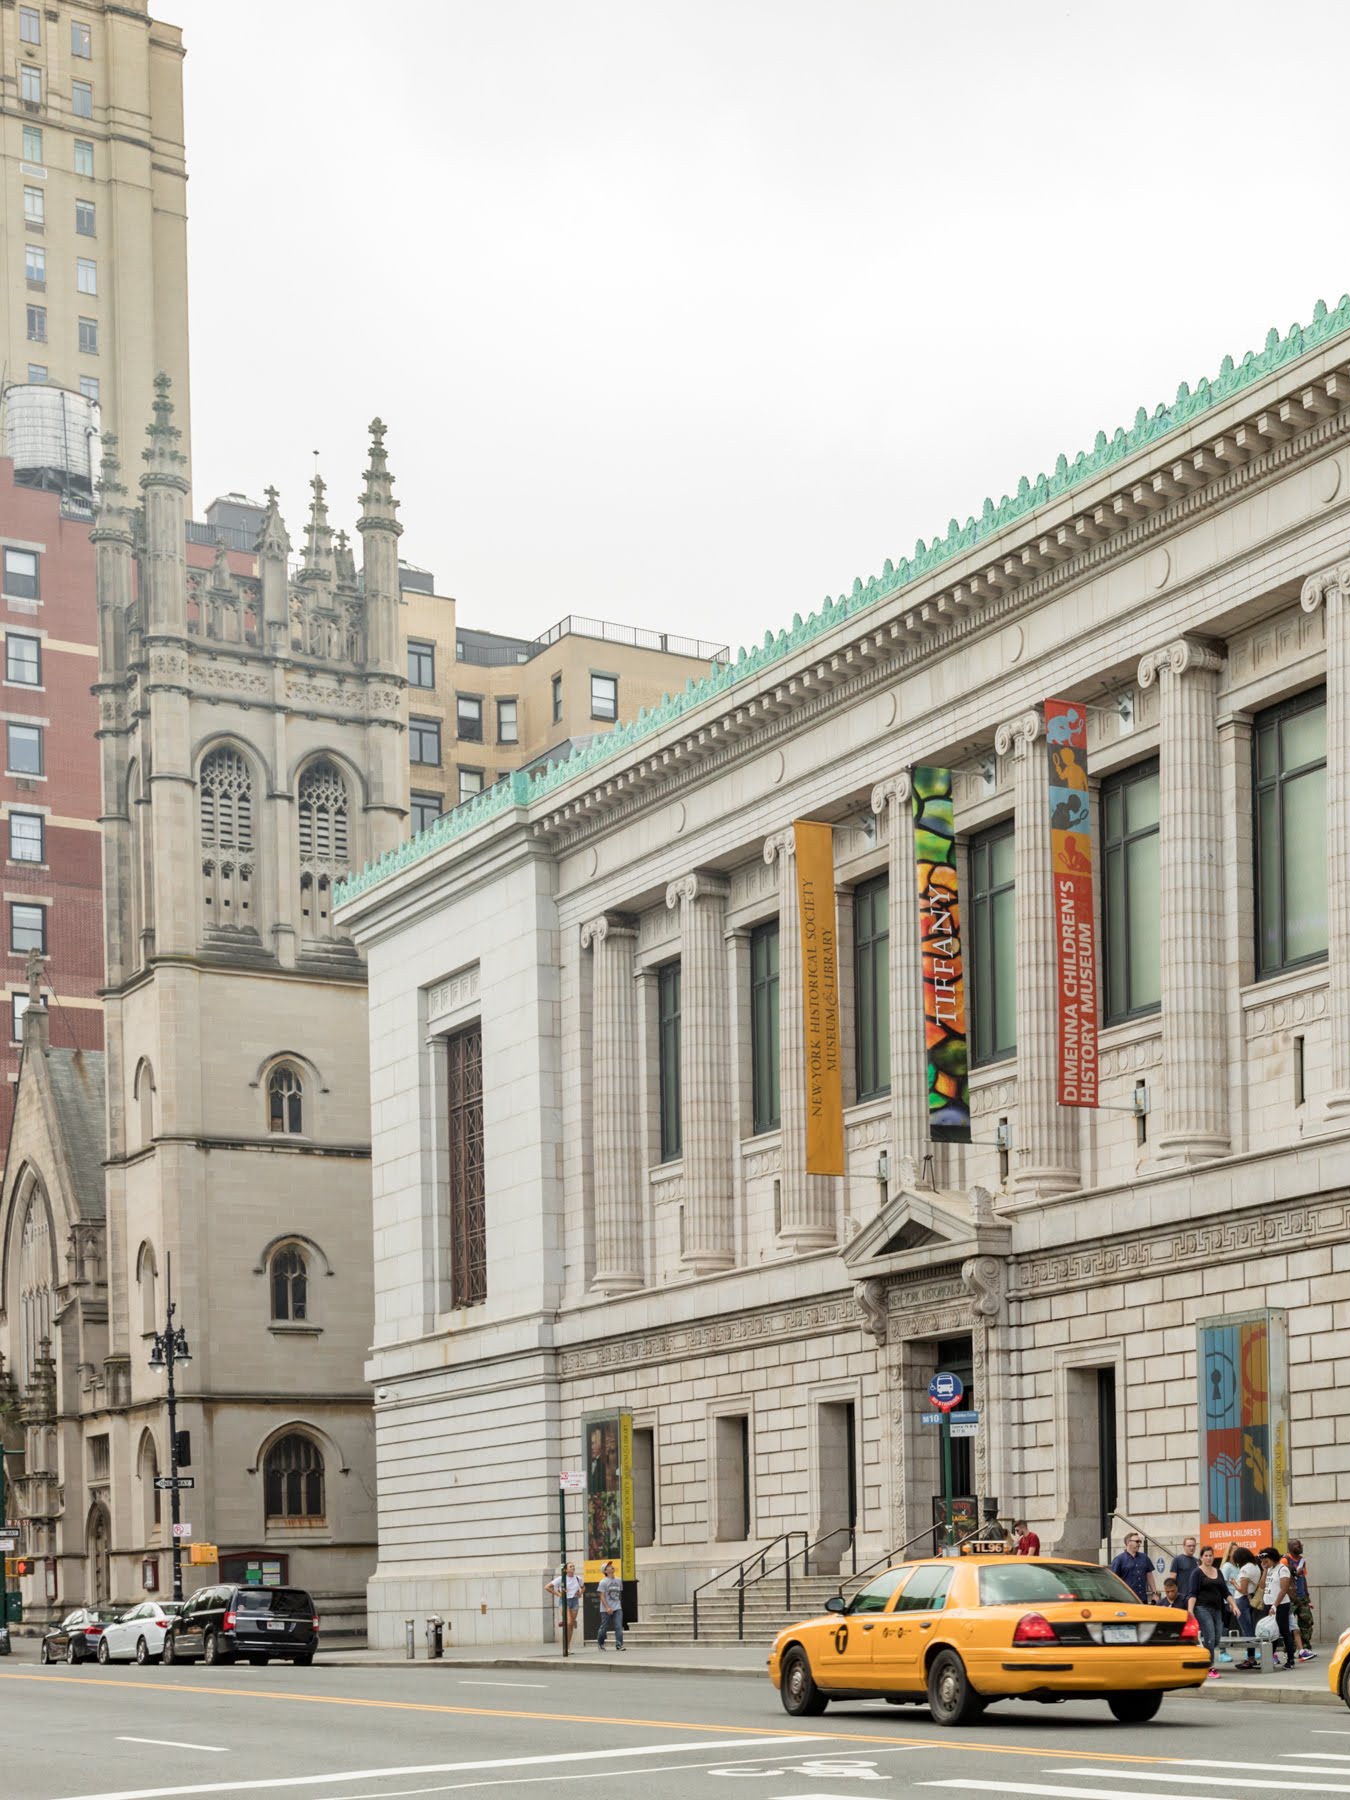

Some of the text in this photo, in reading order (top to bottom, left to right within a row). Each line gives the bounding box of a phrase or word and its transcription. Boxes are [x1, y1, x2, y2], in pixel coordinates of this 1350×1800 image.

[821, 927, 836, 993] LIBRARY
[928, 884, 958, 1028] TIFFANY
[802, 878, 823, 1117] NEW-YORK HISTORICAL SOCIETY
[1059, 880, 1079, 1102] DIMENNA CHILDREN'S
[1077, 922, 1096, 1103] HISTORY MUSEUM
[823, 1008, 838, 1072] MUSEUM
[922, 1414, 940, 1423] M10
[974, 1543, 1003, 1553] 1L96
[1209, 1528, 1262, 1539] DIMENNA CHILDREN'S
